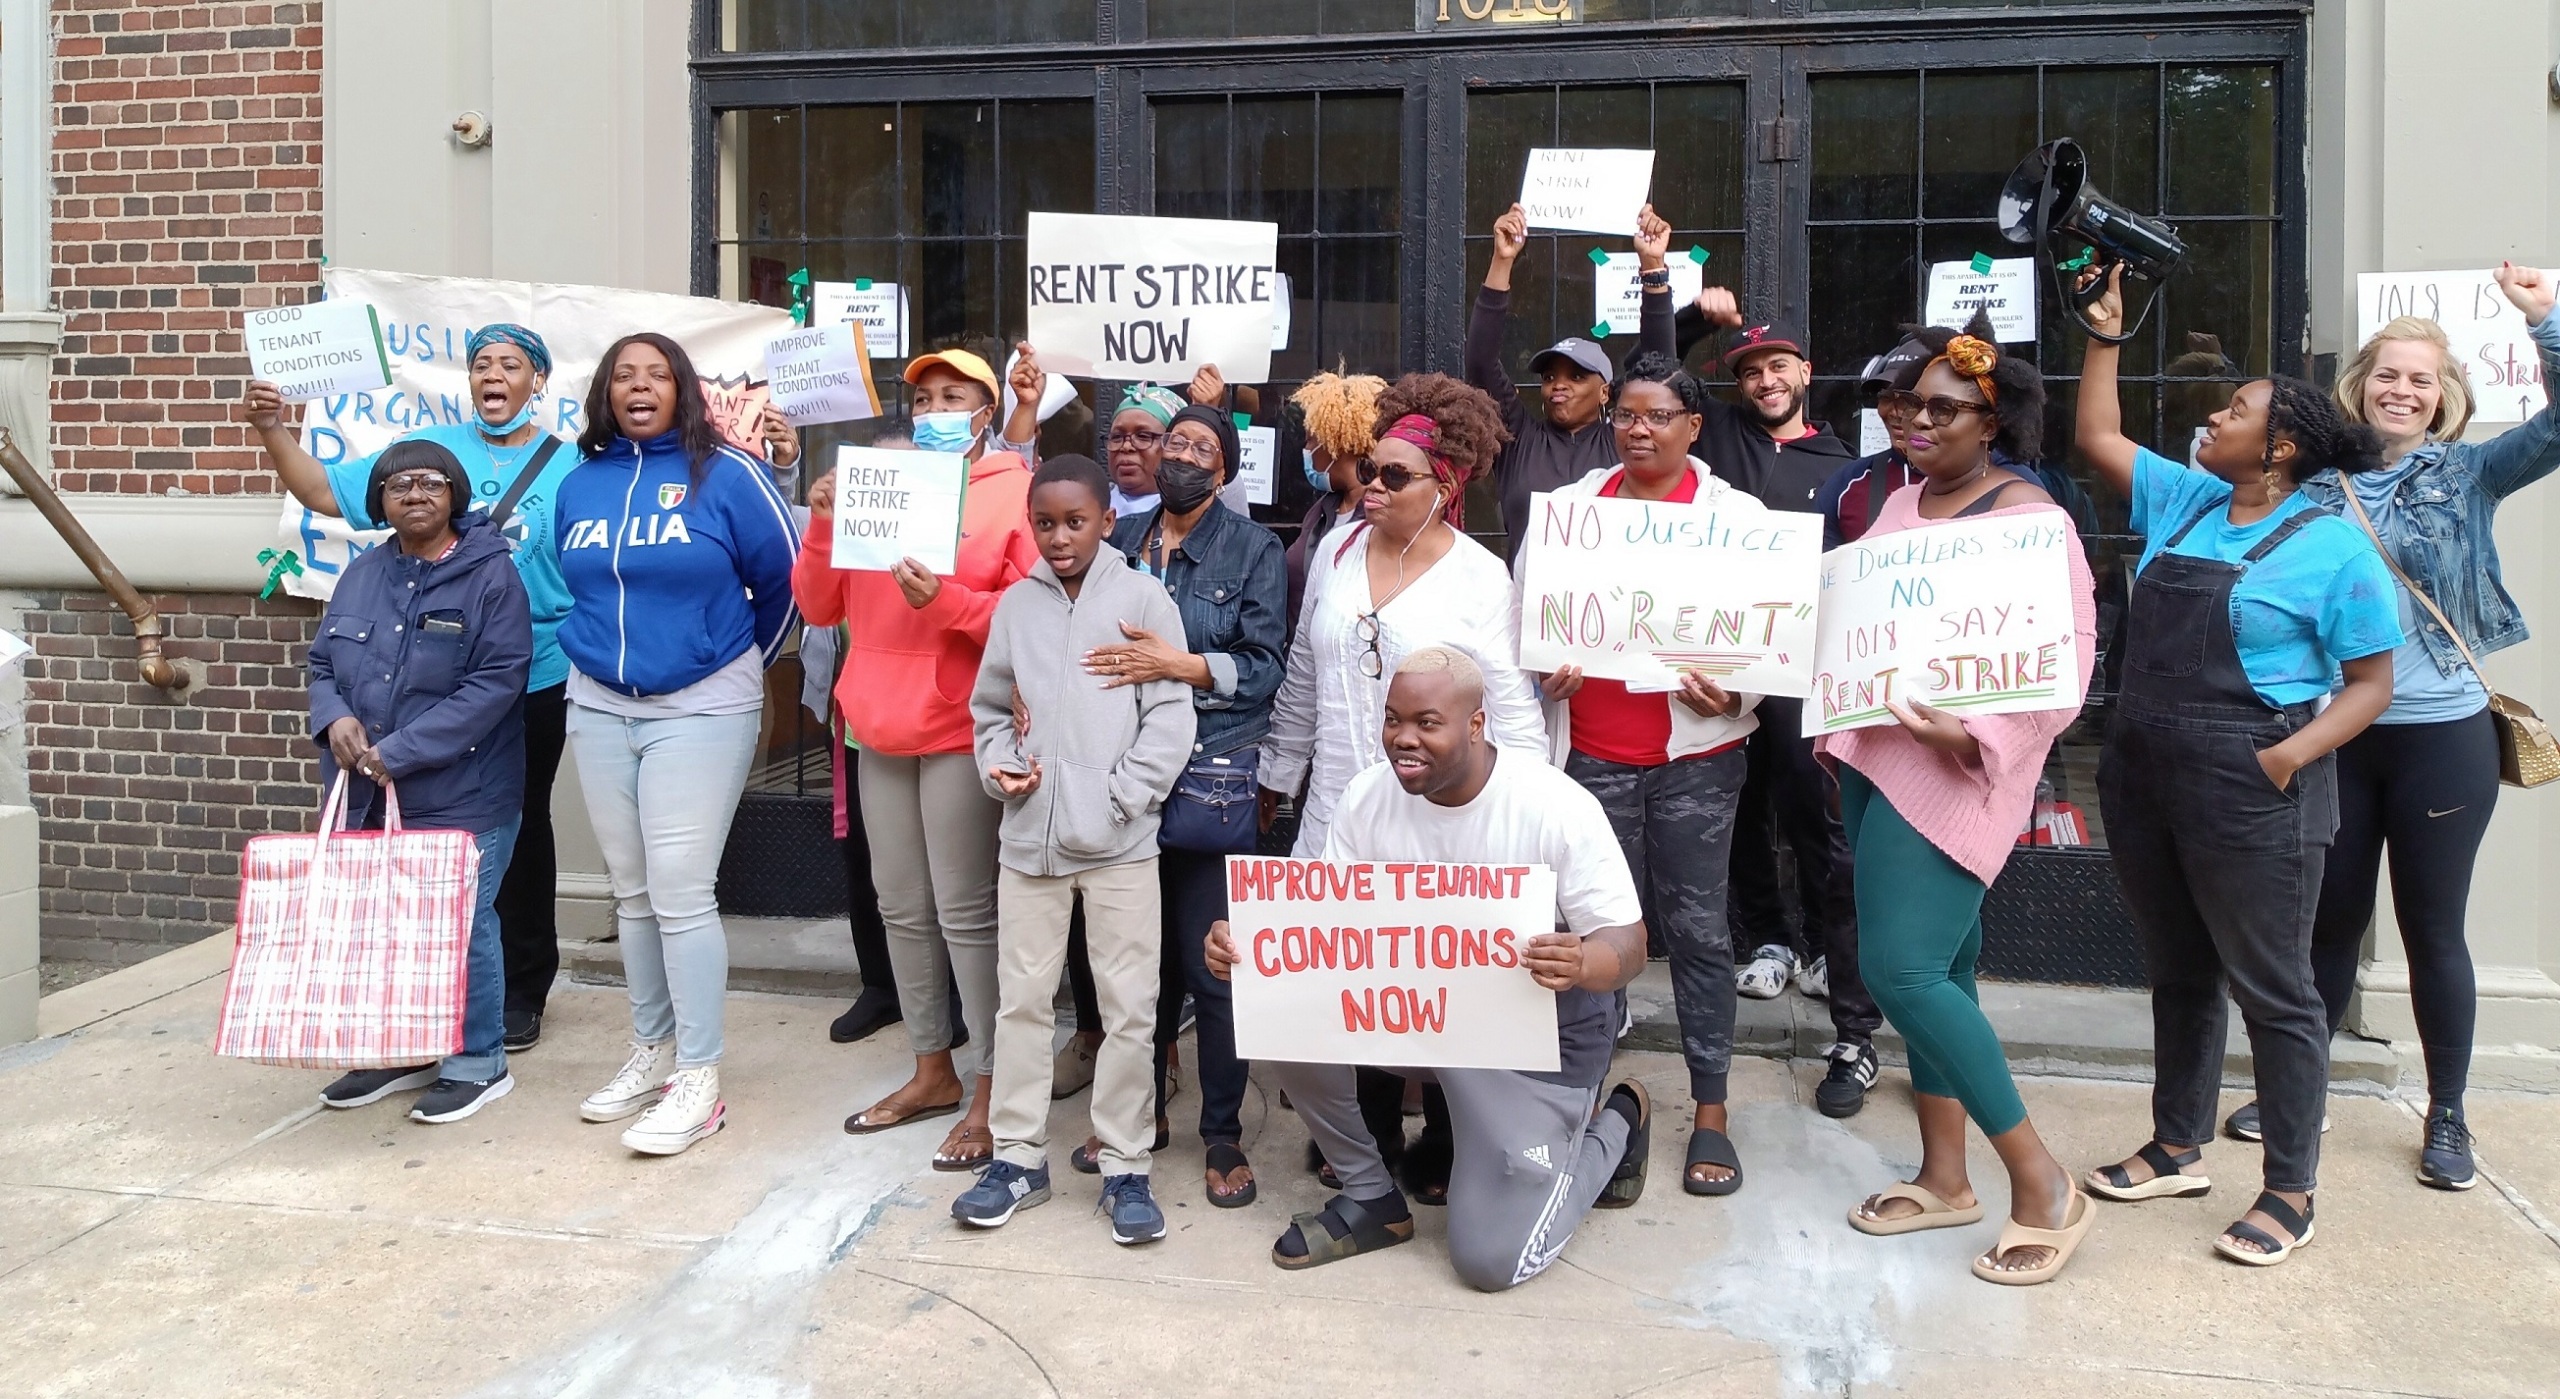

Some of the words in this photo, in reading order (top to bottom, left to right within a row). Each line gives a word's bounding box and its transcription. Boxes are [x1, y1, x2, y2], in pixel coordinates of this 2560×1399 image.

[1030, 263, 1126, 307] RENT
[1133, 263, 1273, 309] STRIKE
[1959, 283, 1999, 294] RENT
[846, 304, 880, 313] RENT
[1951, 298, 2007, 310] STRKE
[2473, 283, 2502, 321] IS
[254, 307, 303, 326] GOOD
[258, 330, 323, 352] TENANT
[770, 331, 827, 355] IMPROVE
[1103, 316, 1191, 364] NOW
[263, 348, 363, 376] CONDITIONS
[774, 359, 822, 380] TENANT
[277, 377, 336, 397] OW!!!!
[775, 371, 851, 396] CONDITIONS
[848, 466, 900, 487] RENT
[845, 489, 911, 510] STRIKE
[844, 518, 899, 539] NOW!
[1543, 501, 1602, 551] NO
[1890, 576, 1935, 610] NO
[1846, 620, 1897, 663] 1018
[1230, 859, 1376, 903] IMPROVE
[1385, 864, 1530, 900] TENANT
[1253, 924, 1519, 977] CONDITIONS
[1341, 985, 1448, 1034] NOW
